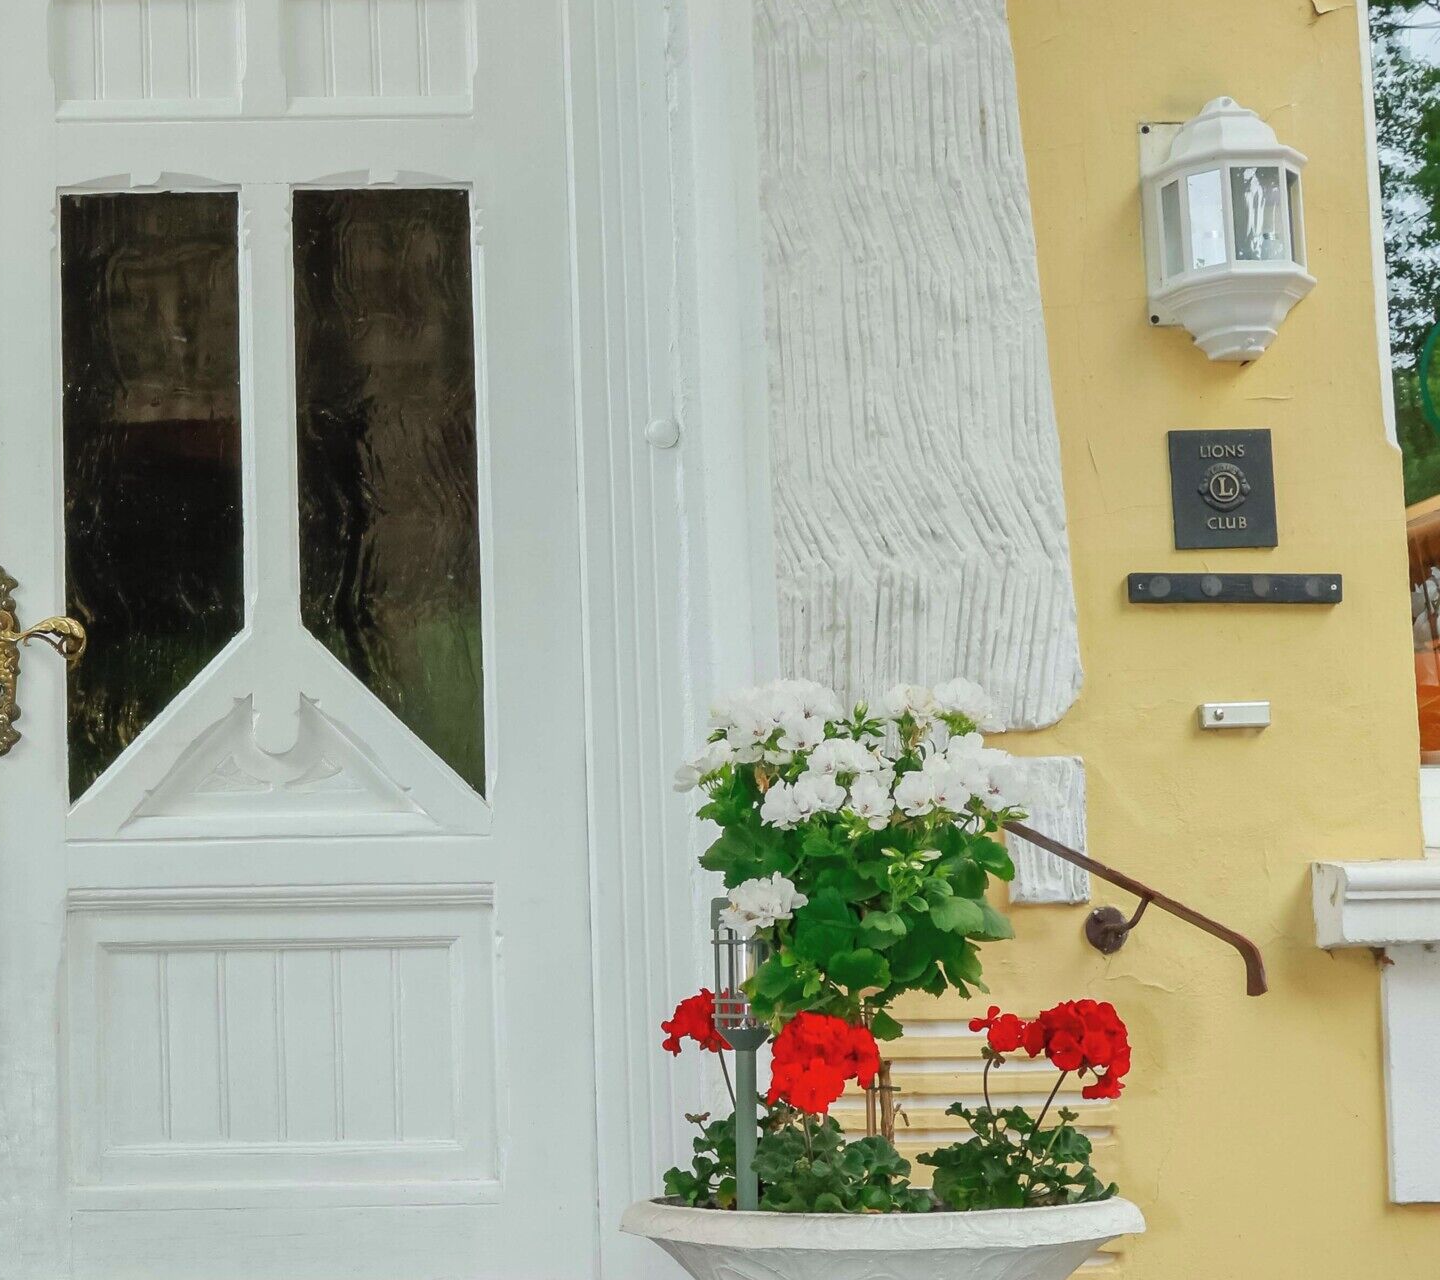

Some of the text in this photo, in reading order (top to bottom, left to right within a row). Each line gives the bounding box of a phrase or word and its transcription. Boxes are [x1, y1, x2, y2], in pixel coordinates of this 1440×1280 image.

[1199, 444, 1246, 458] LIONS
[1217, 476, 1234, 496] L
[1207, 516, 1248, 530] CLUB
